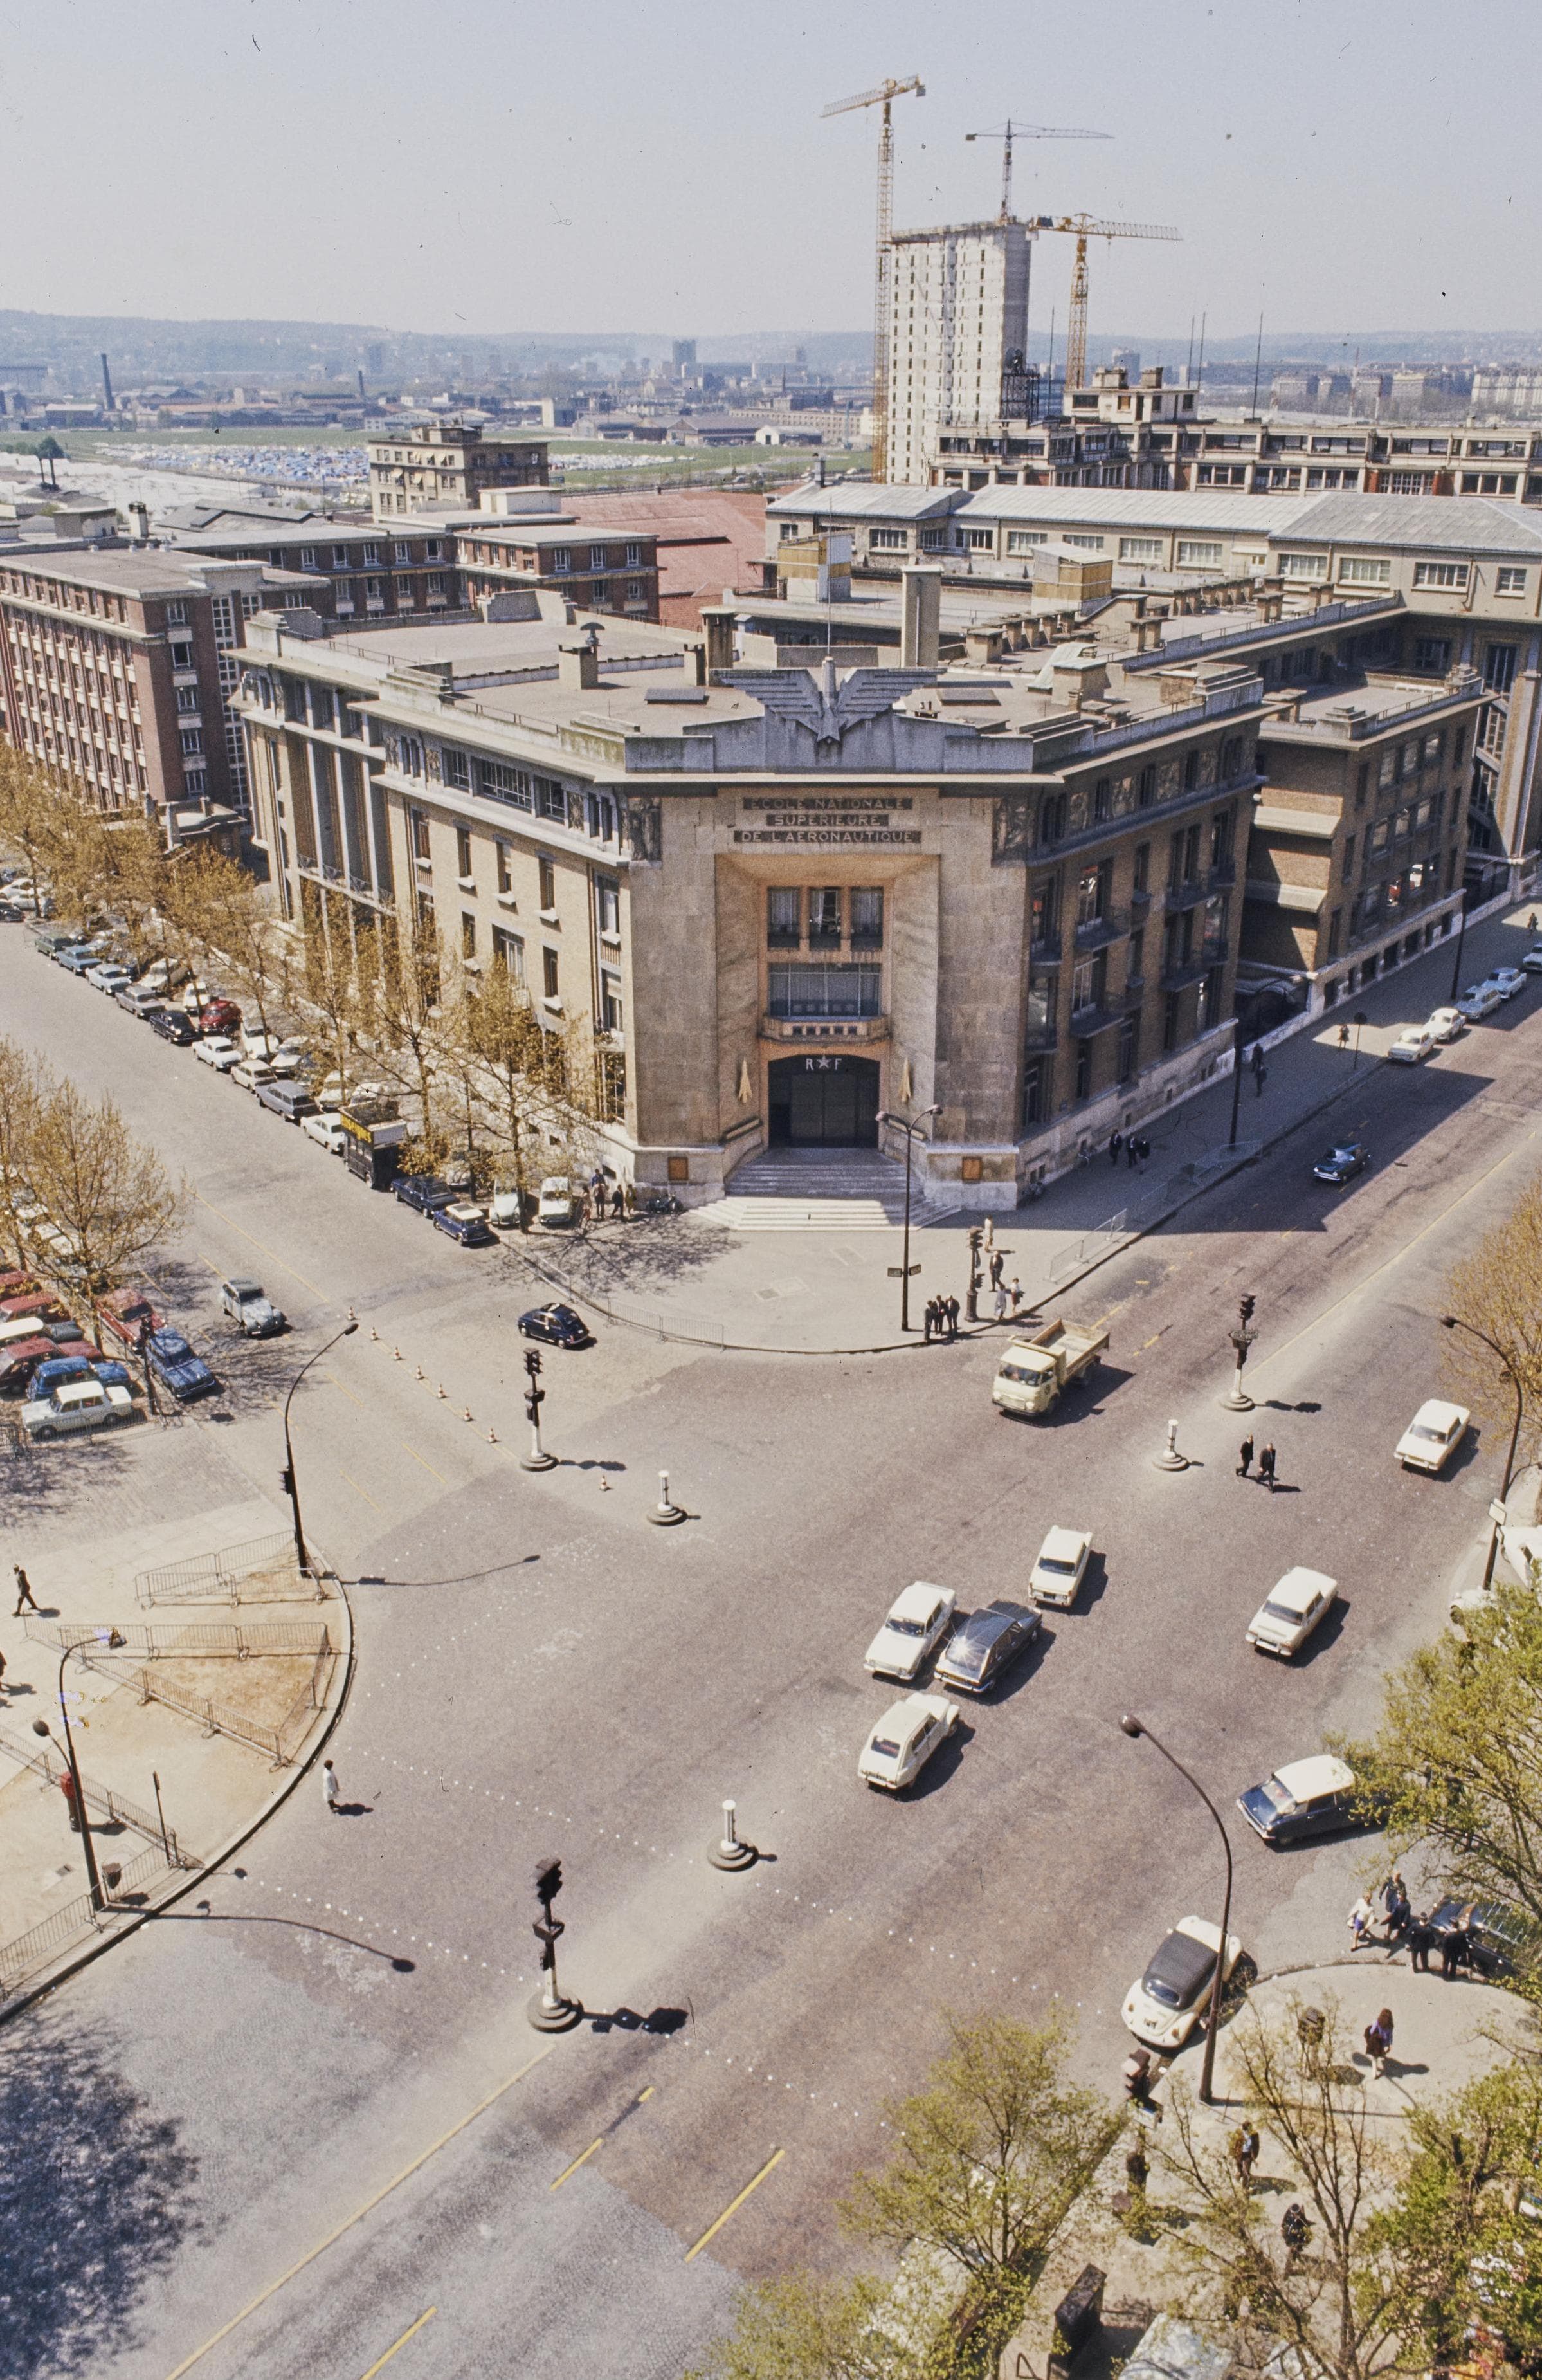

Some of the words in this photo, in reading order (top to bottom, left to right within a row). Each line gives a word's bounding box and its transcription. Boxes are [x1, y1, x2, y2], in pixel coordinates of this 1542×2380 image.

[751, 798, 804, 809] ECOLE
[815, 798, 904, 809] NATIONALE
[774, 815, 880, 826] SUPERIEURE
[741, 832, 762, 842] DE
[806, 1058, 813, 1070] R
[835, 1058, 842, 1070] F
